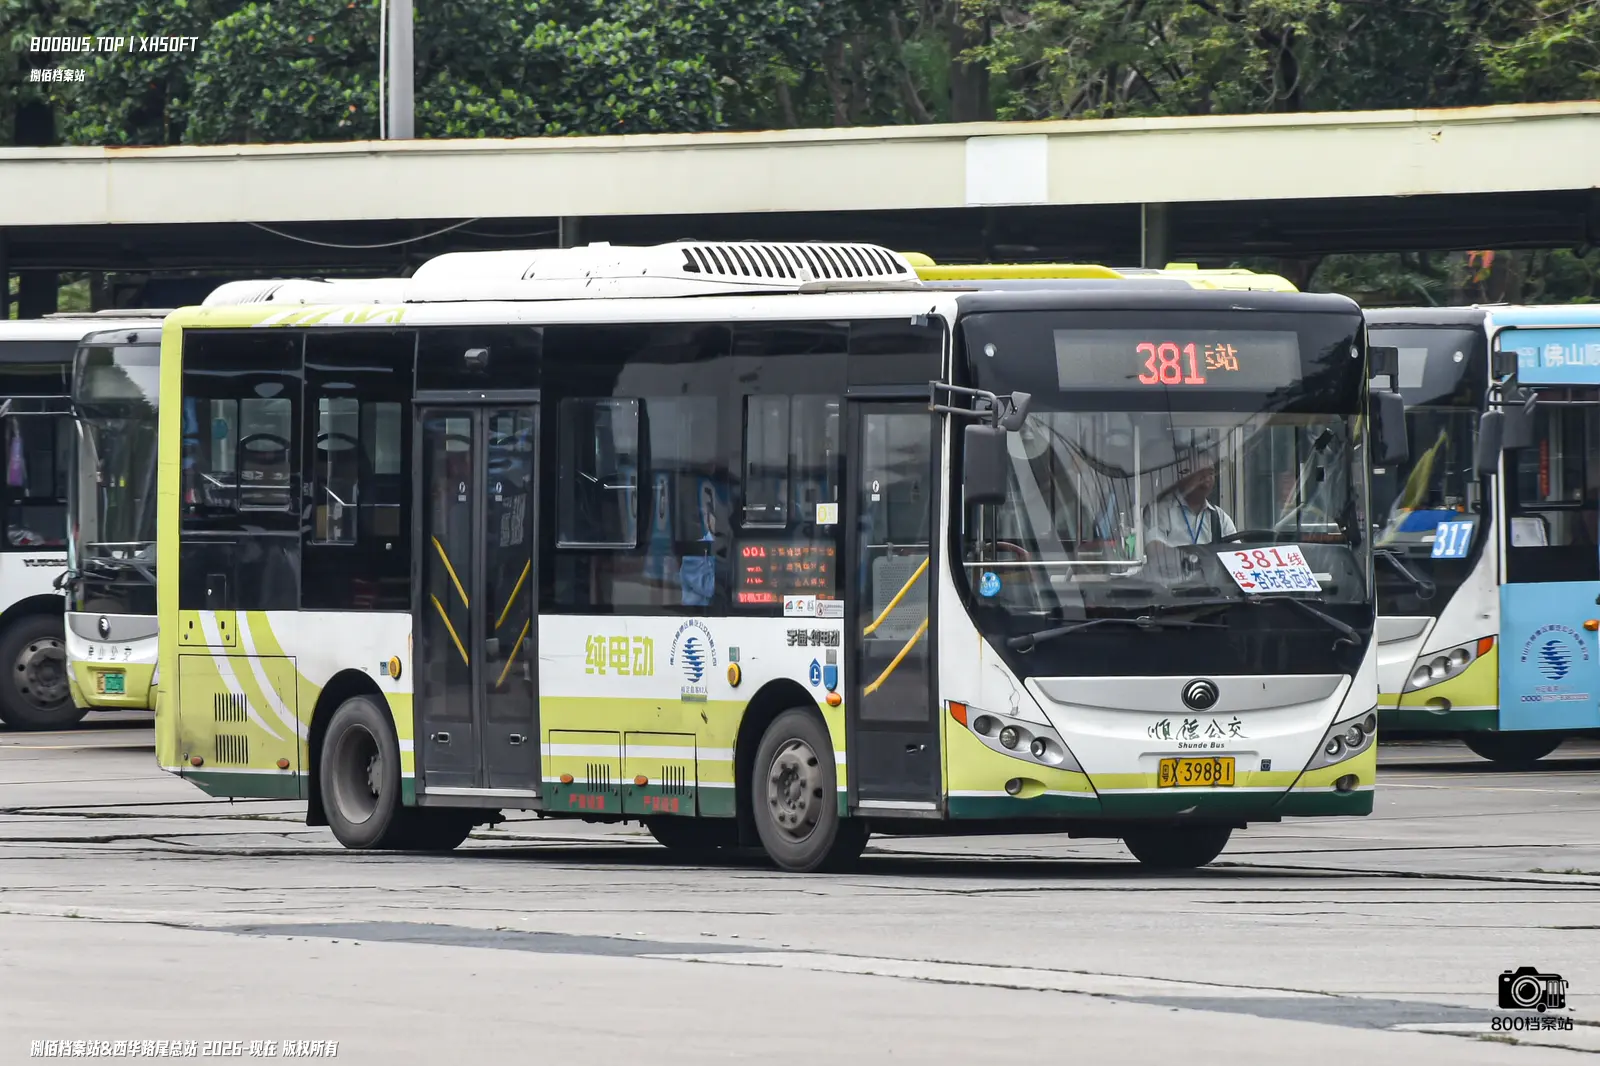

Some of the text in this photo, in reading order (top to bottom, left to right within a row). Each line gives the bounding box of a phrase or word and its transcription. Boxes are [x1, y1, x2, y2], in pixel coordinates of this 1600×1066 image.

[1136, 343, 1207, 385] 381
[1433, 523, 1473, 556] 317
[1250, 567, 1319, 590] 杏坛客运站
[585, 634, 655, 677] 纯电动
[1148, 716, 1249, 740] 顺德公交
[1178, 741, 1226, 749] Shunde Bus
